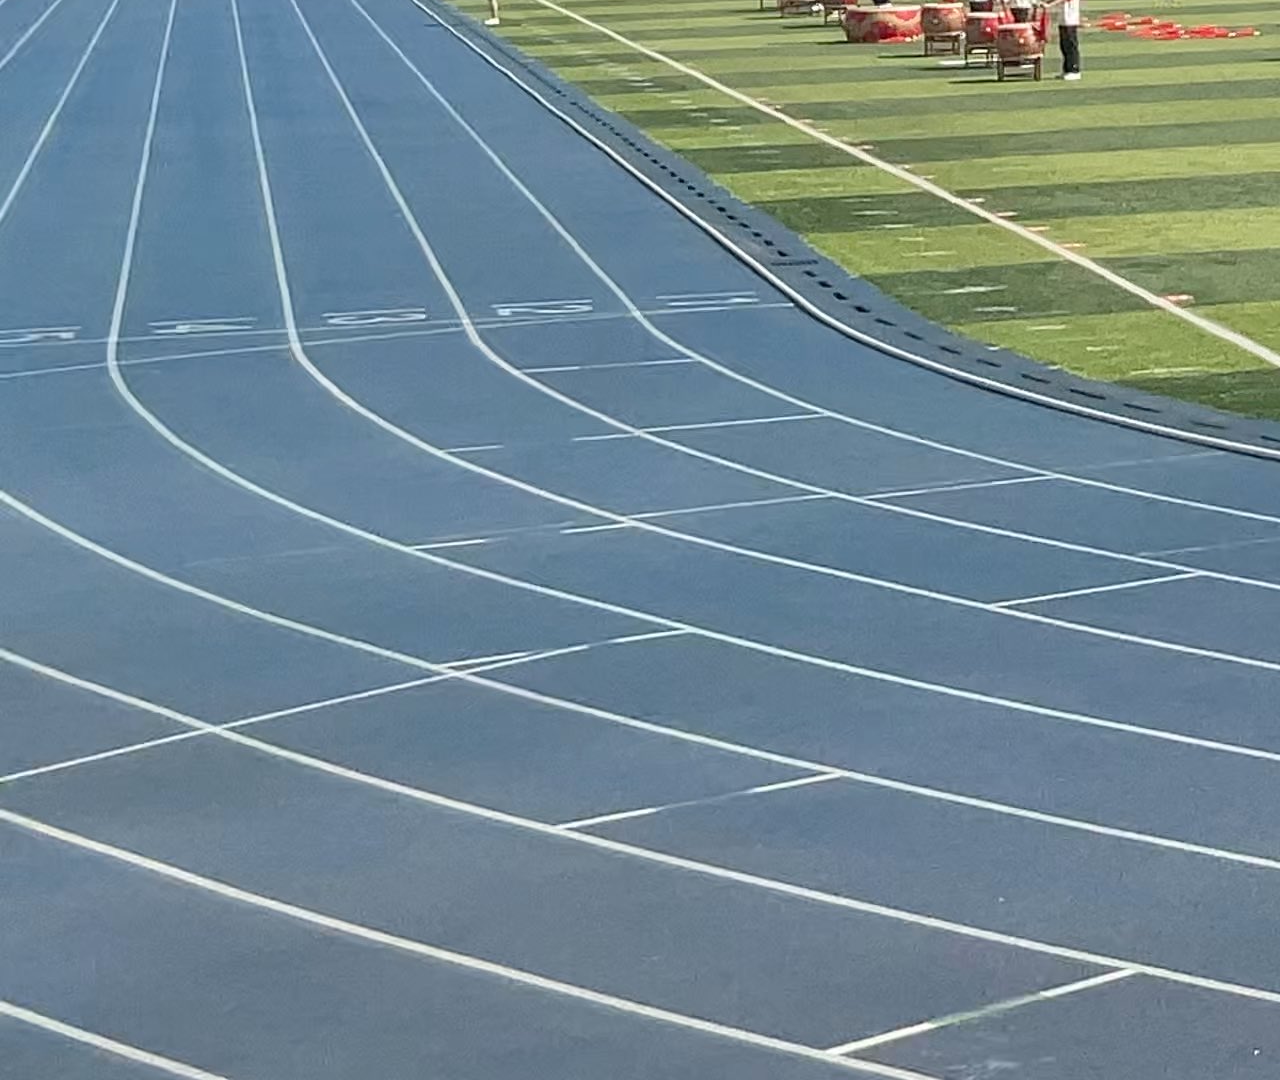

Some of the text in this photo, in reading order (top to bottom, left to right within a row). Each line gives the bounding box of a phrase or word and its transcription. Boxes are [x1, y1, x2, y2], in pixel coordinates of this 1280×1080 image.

[497, 304, 593, 316] 2
[327, 313, 426, 325] 3
[152, 324, 253, 335] 4
